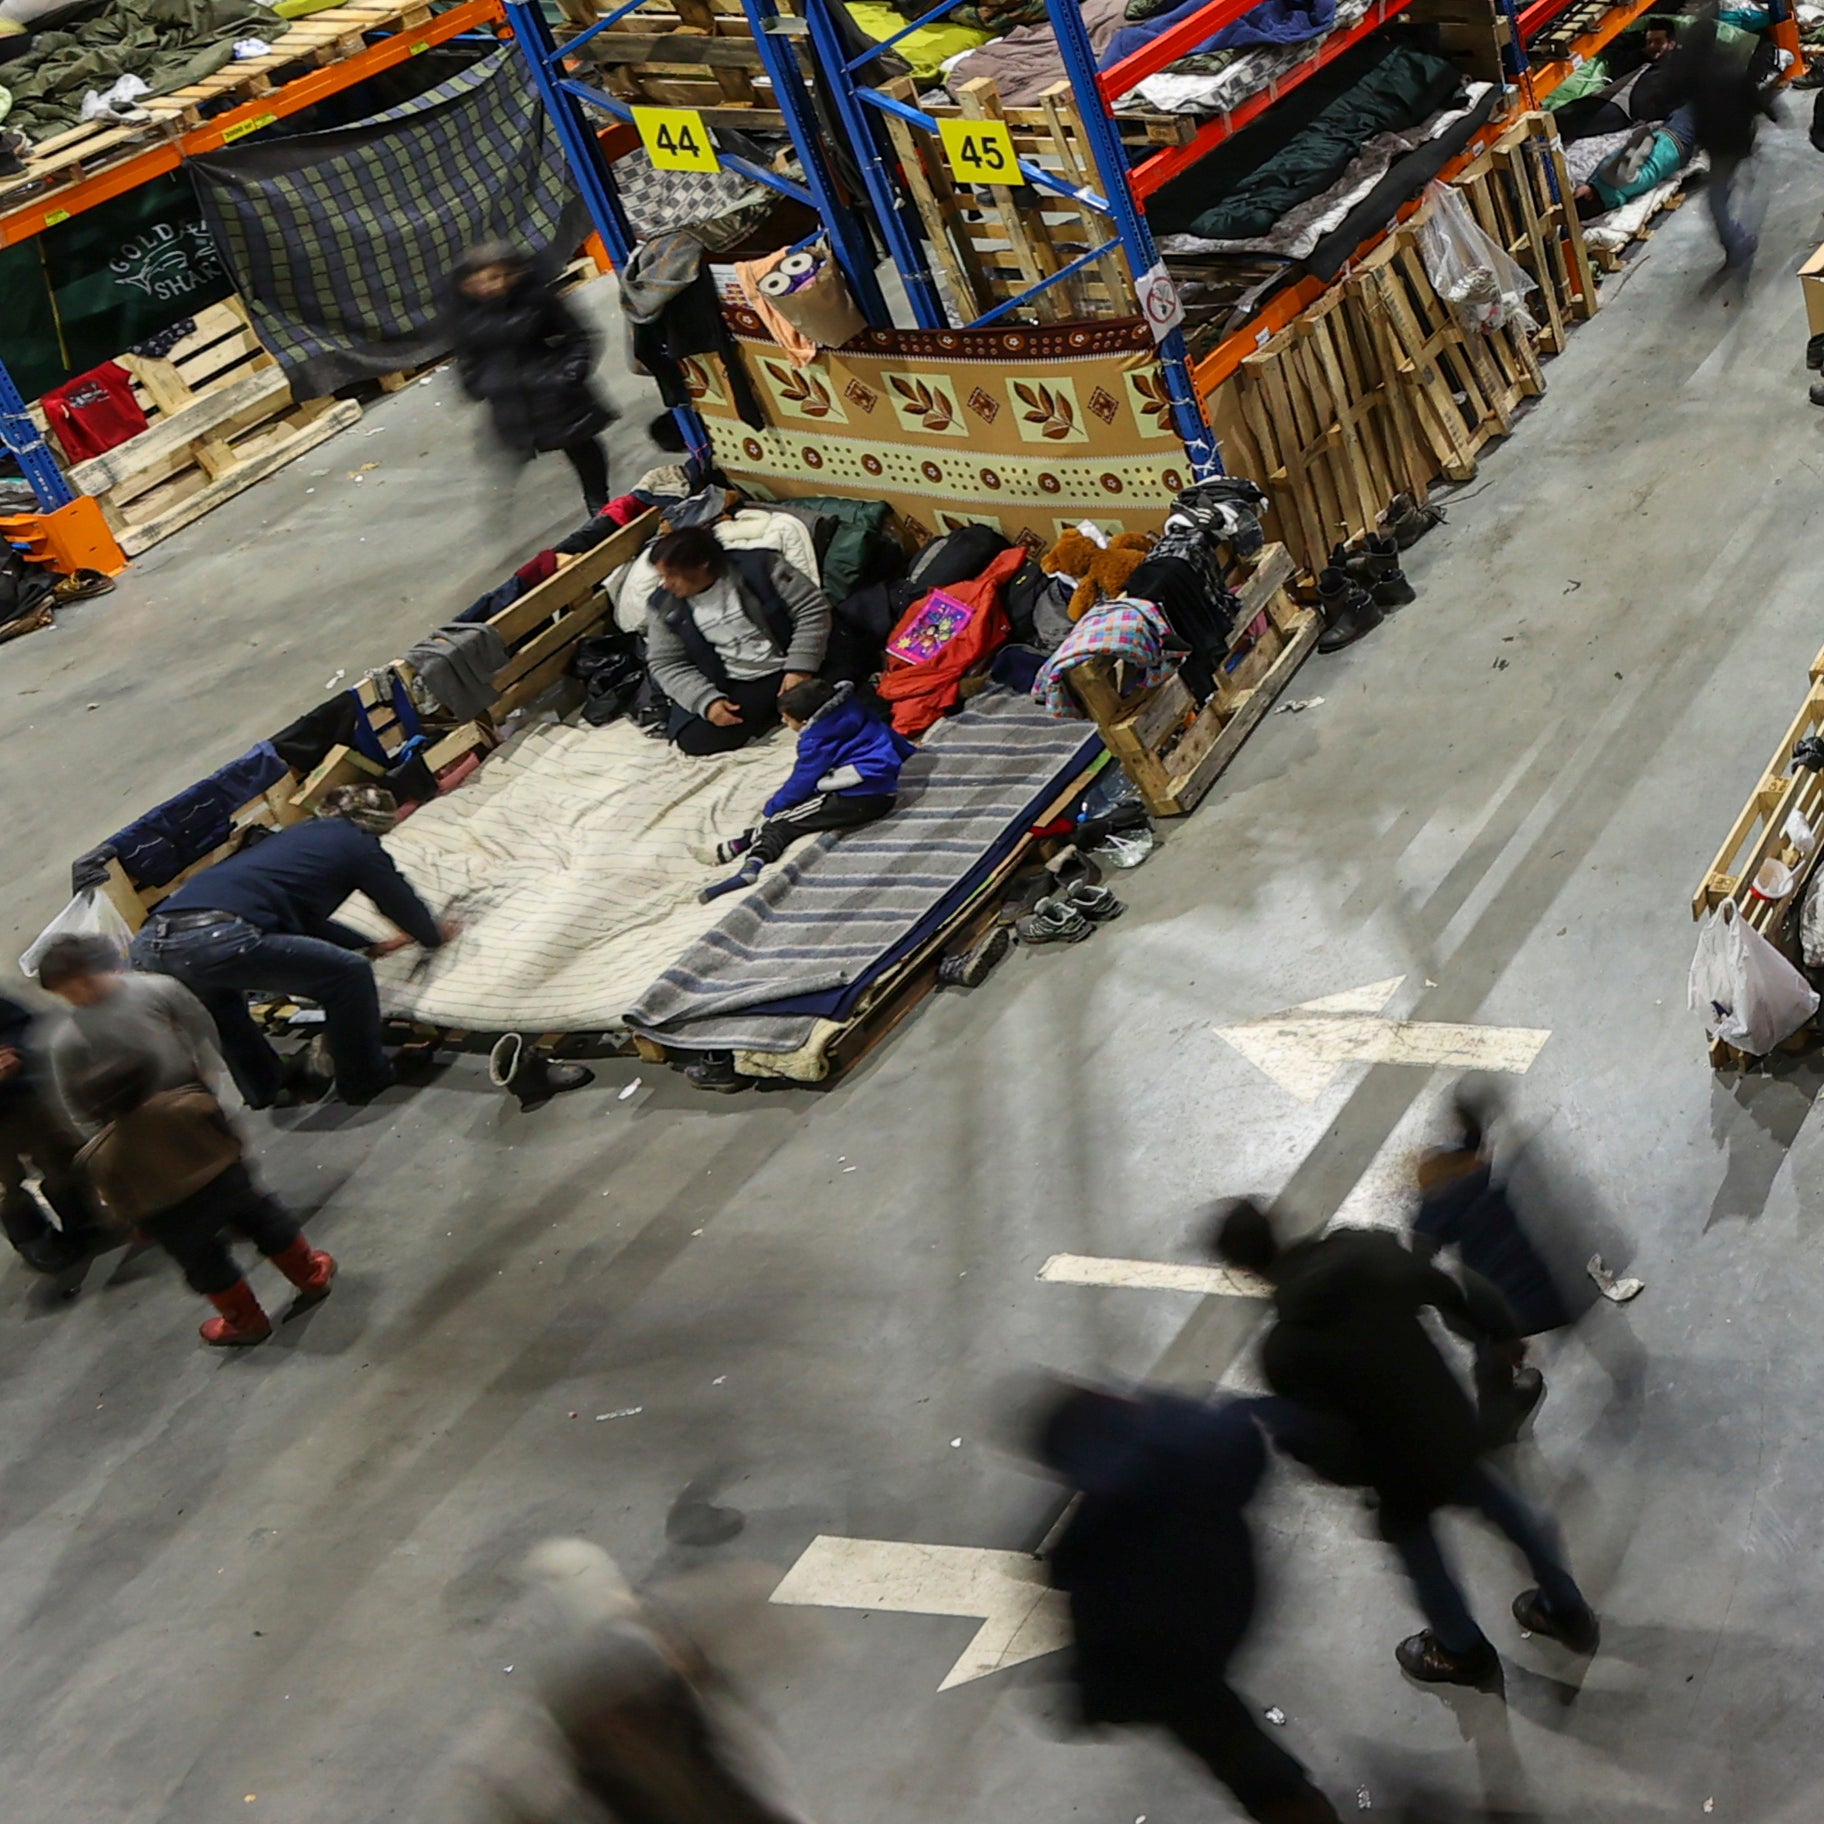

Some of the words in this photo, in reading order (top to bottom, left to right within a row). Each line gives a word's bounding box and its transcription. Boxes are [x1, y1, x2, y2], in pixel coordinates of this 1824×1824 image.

[656, 123, 699, 157] 44
[961, 135, 1005, 169] 45
[154, 261, 222, 300] SHAR
